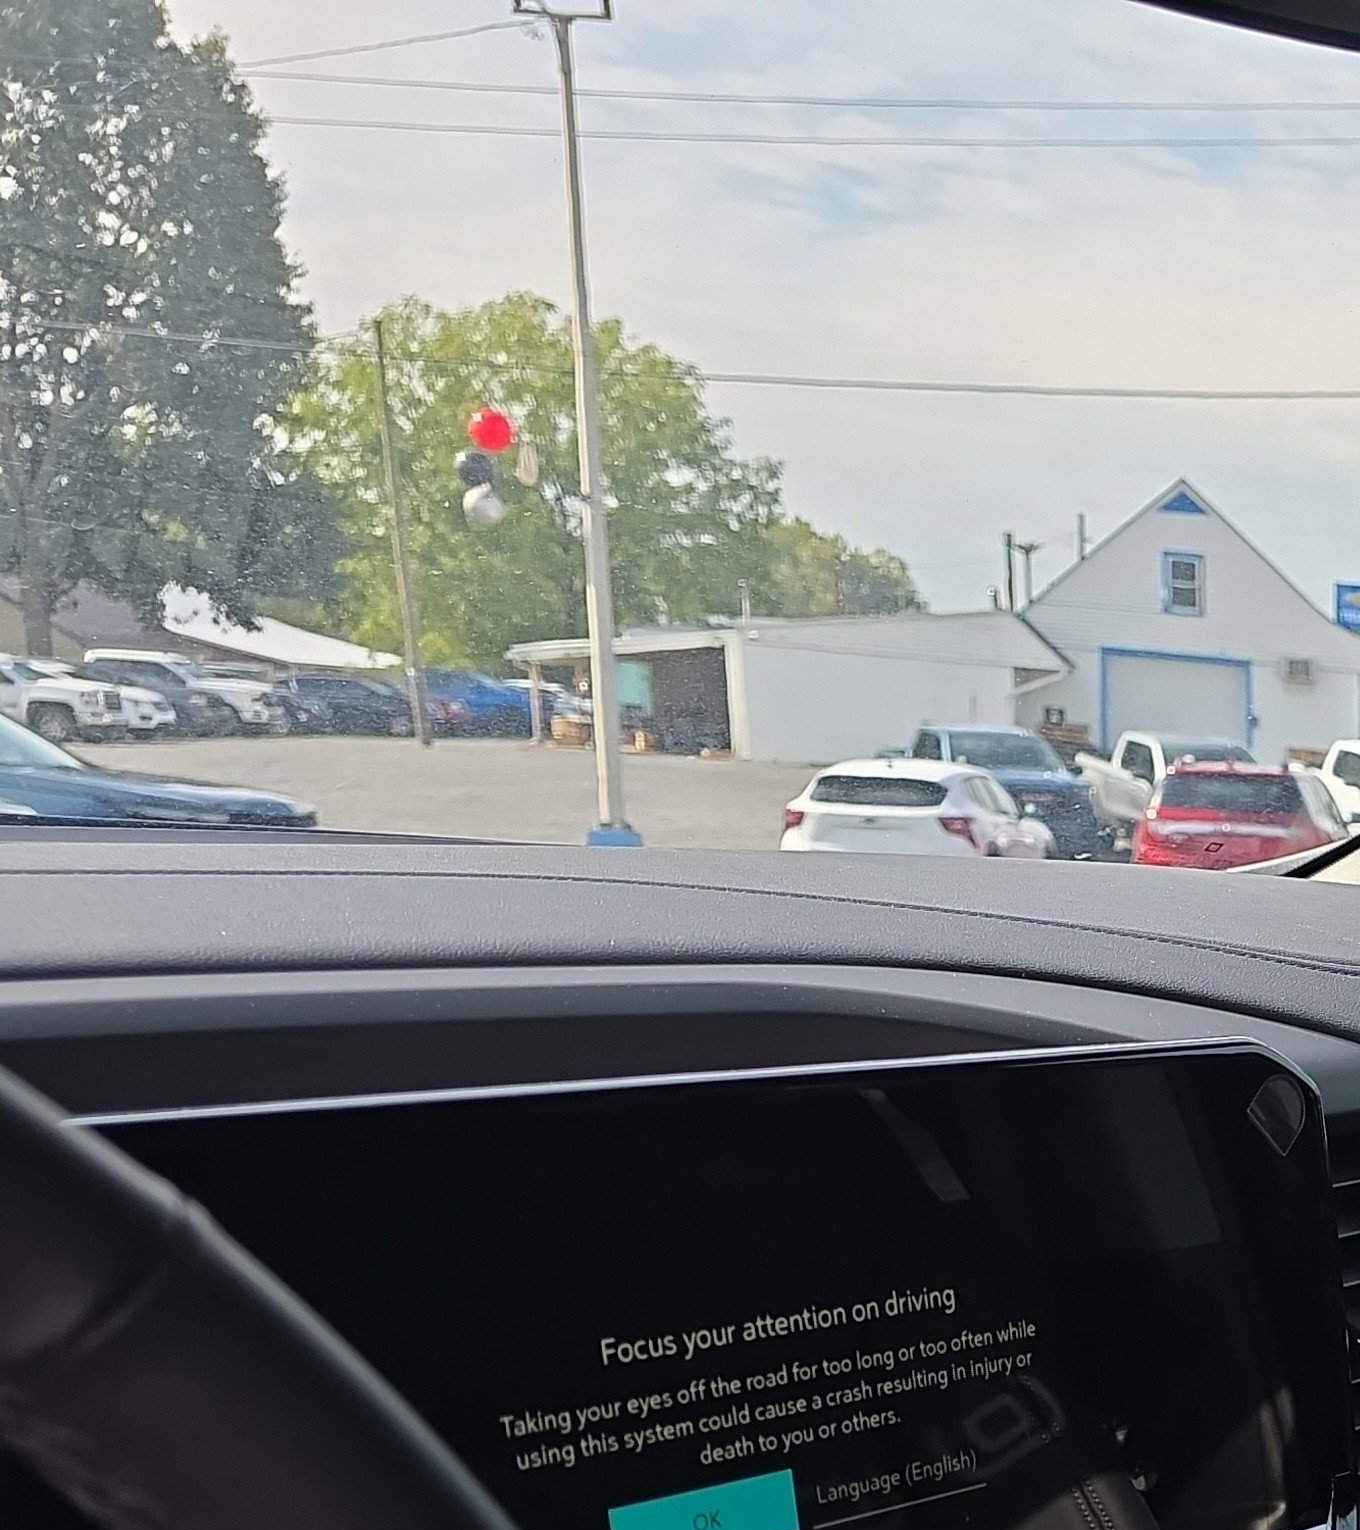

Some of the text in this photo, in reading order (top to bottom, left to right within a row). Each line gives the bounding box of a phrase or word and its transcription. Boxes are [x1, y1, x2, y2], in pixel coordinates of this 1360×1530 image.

[600, 1286, 956, 1366] Focus your attention on driving
[499, 1319, 1036, 1439] Taking your eyes off the road for too long or too often while
[516, 1352, 1033, 1470] using this system could cause a crash resulting in injury or
[699, 1410, 902, 1465] death to you or others.
[816, 1449, 977, 1504] Language (English)
